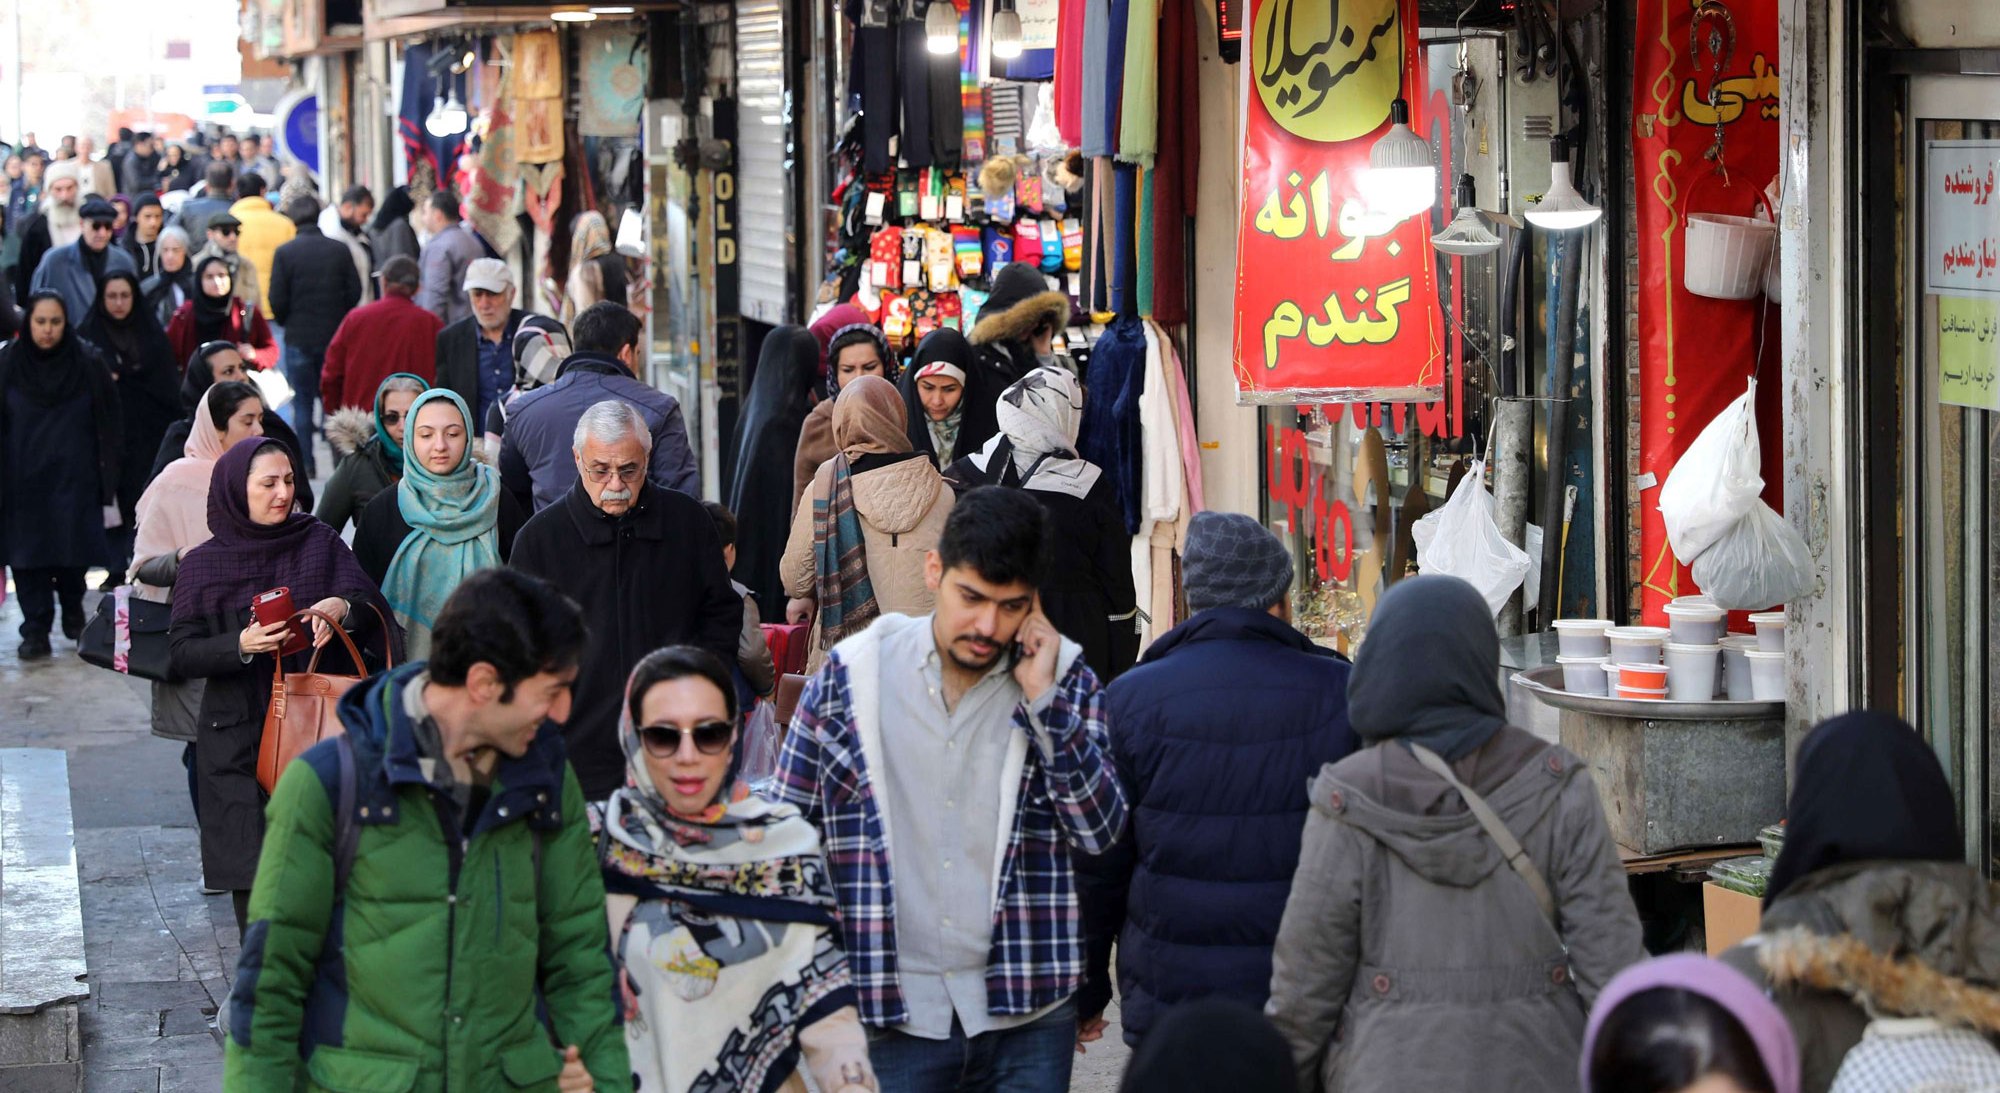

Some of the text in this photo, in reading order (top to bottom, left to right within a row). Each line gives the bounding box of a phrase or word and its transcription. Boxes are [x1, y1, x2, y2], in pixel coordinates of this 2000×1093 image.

[1944, 161, 1994, 205] فروشنده
[1943, 237, 1997, 279] نیازمندیم
[1263, 276, 1411, 370] گندم
[1977, 316, 1997, 343] فرش
[1267, 424, 1353, 582] up to
